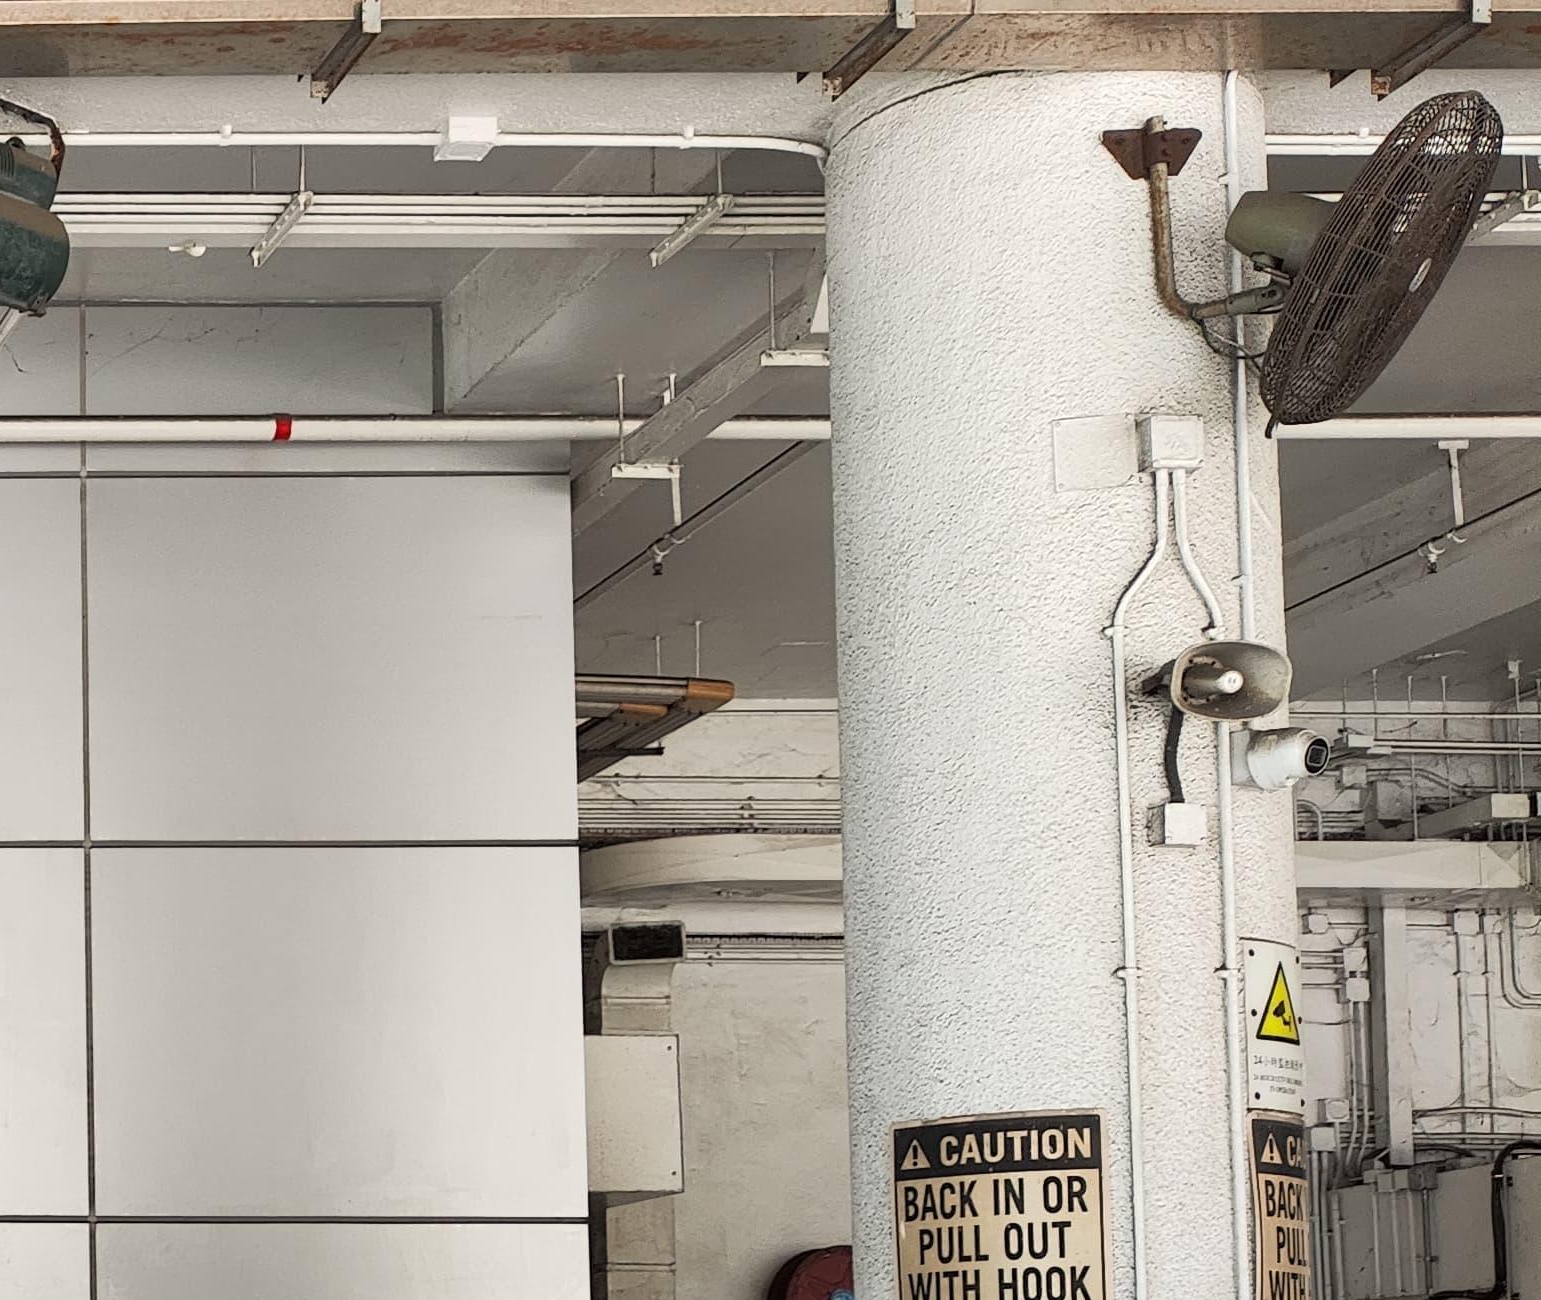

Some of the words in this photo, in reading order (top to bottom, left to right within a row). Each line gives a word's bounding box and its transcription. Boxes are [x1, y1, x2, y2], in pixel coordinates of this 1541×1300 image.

[939, 1127, 1092, 1167] CAUTION
[904, 1179, 979, 1222] BACK
[993, 1177, 1025, 1216] IN
[1043, 1175, 1088, 1214] OR
[1265, 1179, 1303, 1220] BACK
[919, 1225, 989, 1265] PULL
[1004, 1221, 1071, 1261] OUT
[1277, 1226, 1306, 1266] PULL
